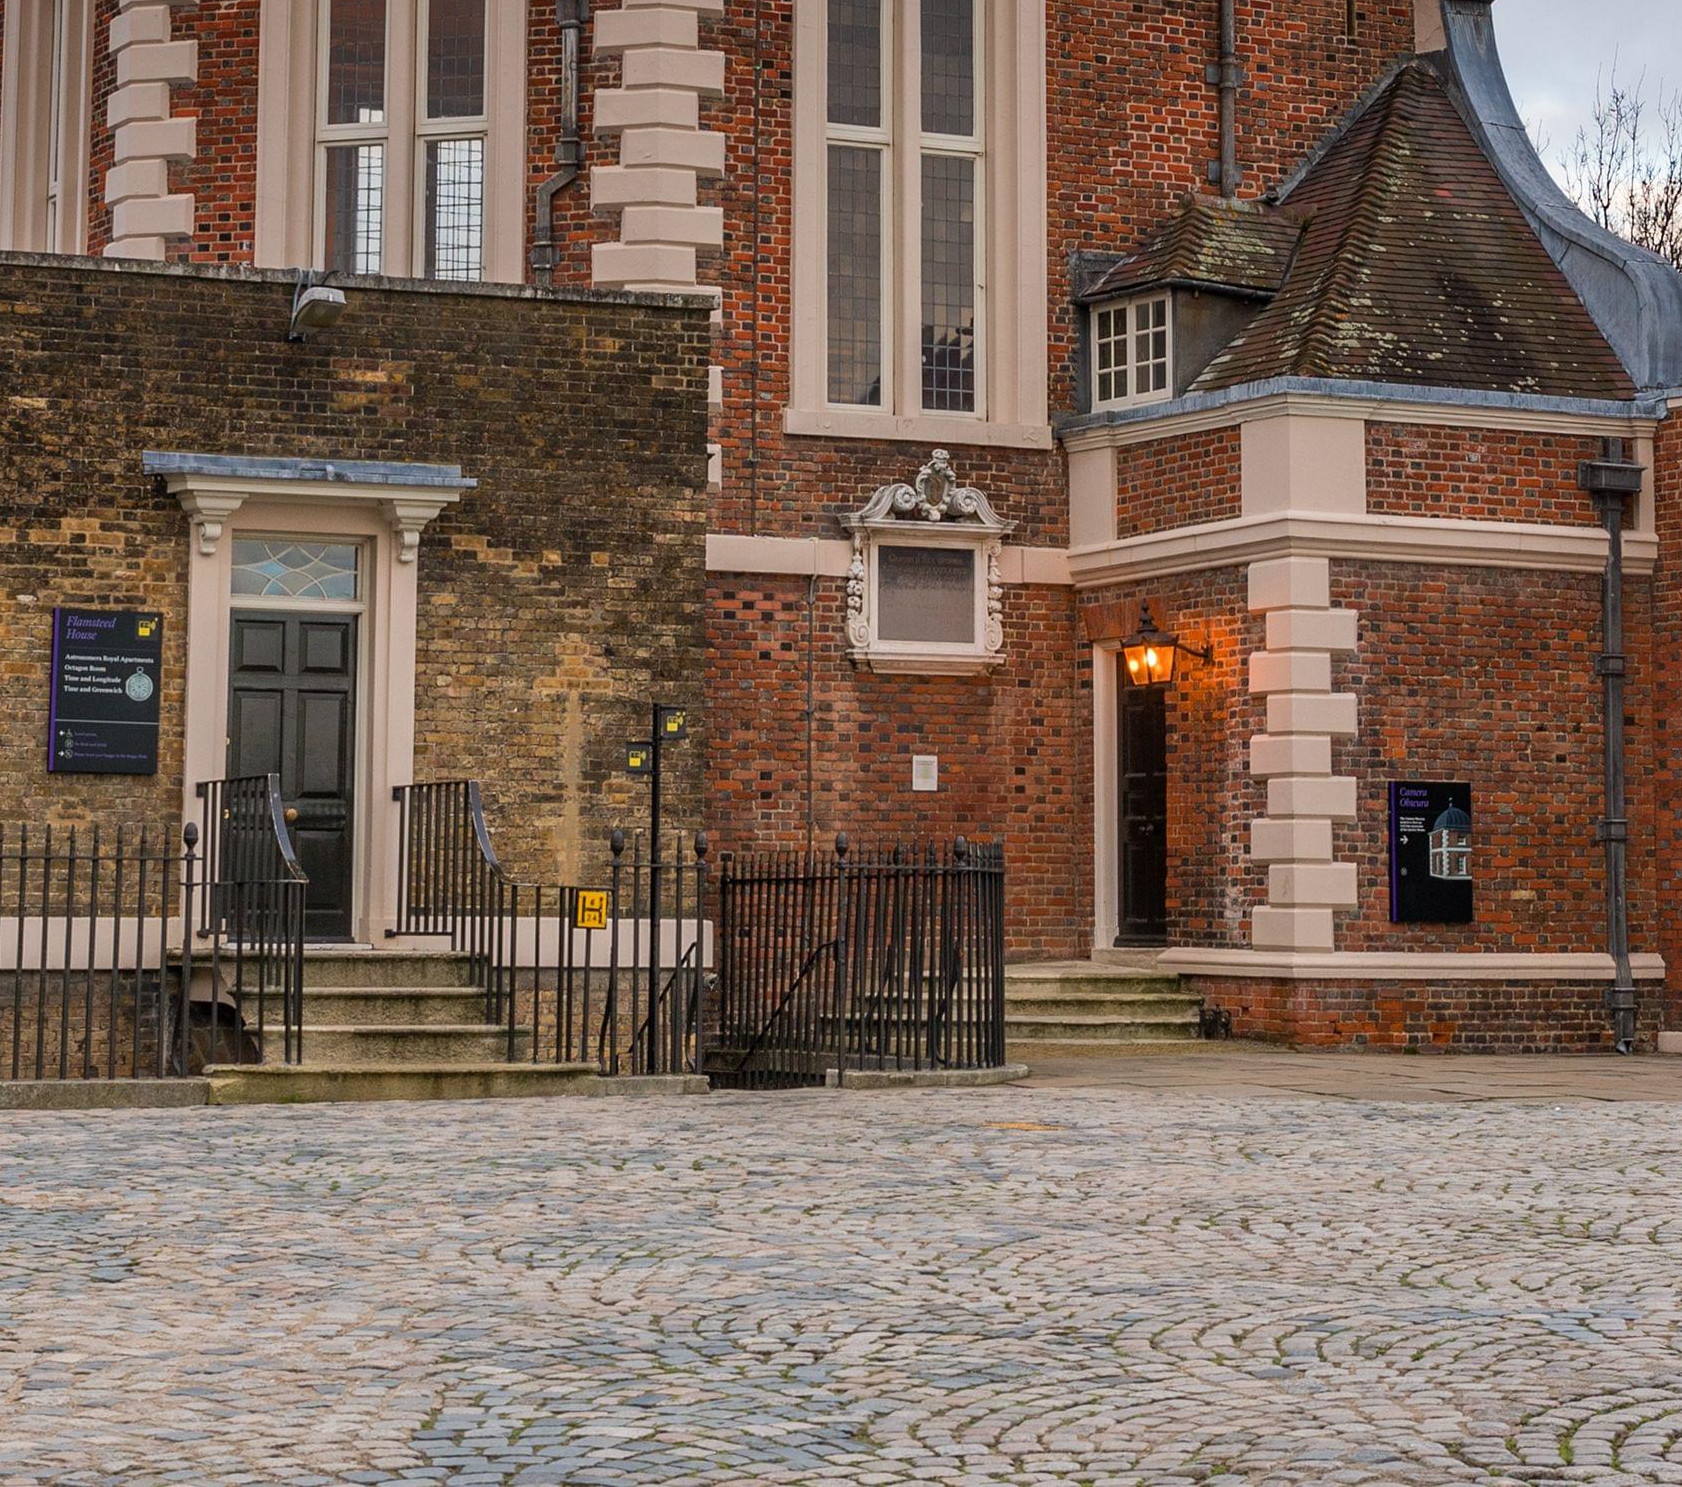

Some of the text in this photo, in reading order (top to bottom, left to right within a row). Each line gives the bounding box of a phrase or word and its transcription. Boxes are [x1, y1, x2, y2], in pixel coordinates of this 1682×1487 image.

[66, 615, 117, 629] Flamsteed
[65, 628, 98, 640] House
[103, 655, 120, 663] Royal
[120, 656, 155, 664] Apartments
[64, 664, 89, 673] Octagon
[63, 674, 122, 685] Time and Longitude
[63, 685, 79, 693] Time
[91, 686, 123, 694] Greenwich
[1399, 786, 1428, 797] Camera
[1399, 798, 1430, 808] Obscura
